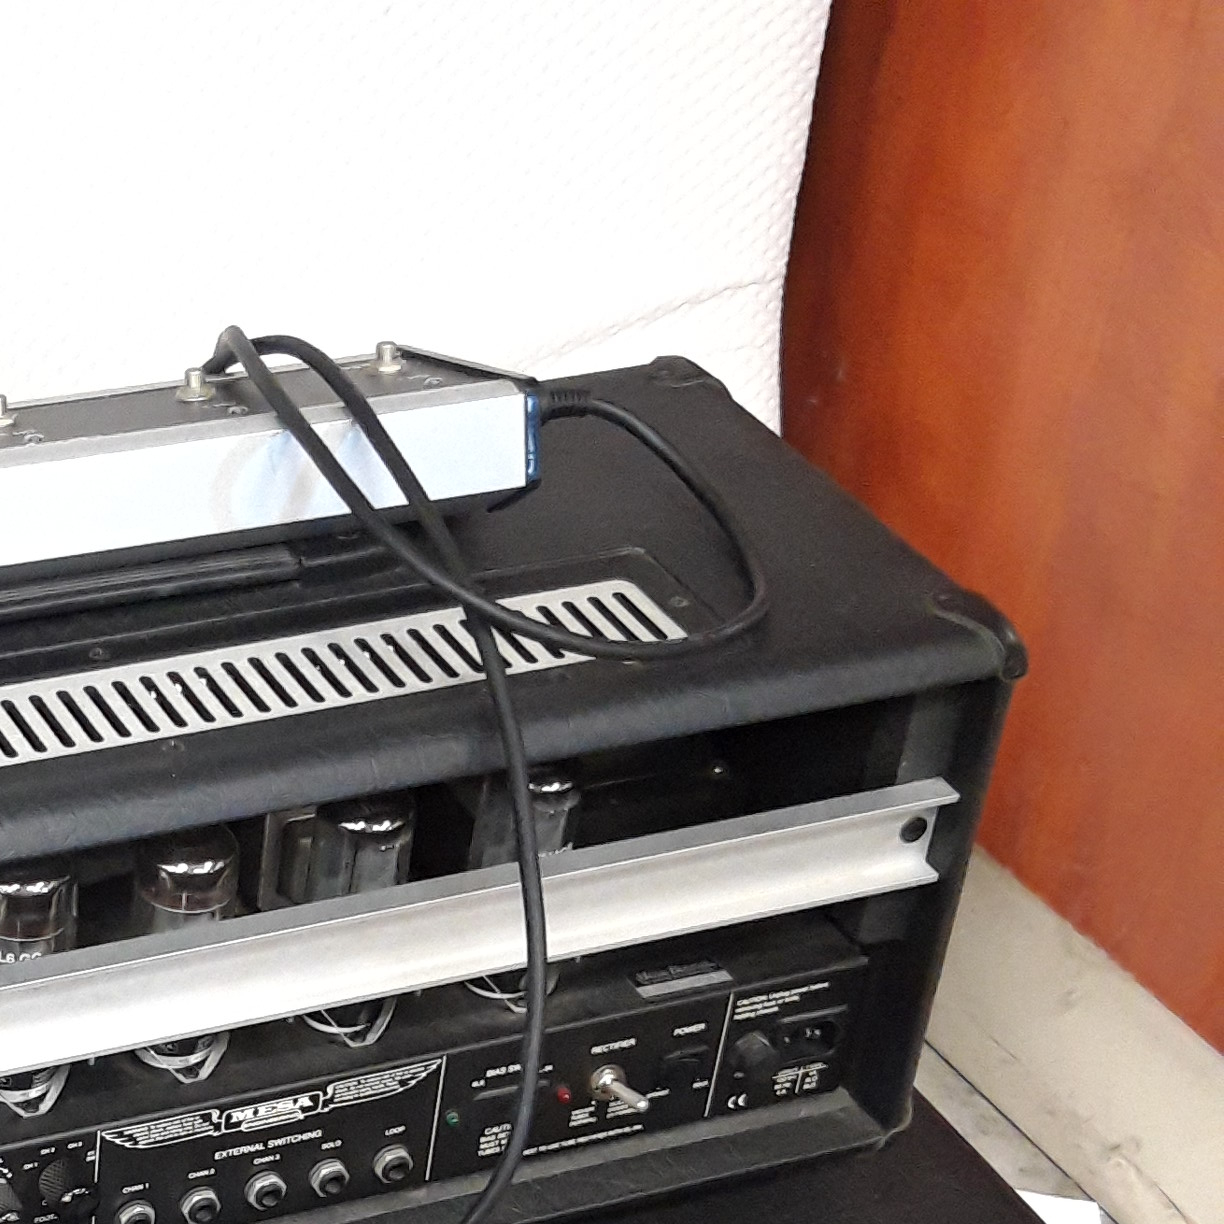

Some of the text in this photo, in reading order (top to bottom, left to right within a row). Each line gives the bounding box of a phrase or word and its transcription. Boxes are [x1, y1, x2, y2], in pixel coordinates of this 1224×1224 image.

[230, 1096, 314, 1123] MESA
[214, 1129, 323, 1160] EXTERNAL SWITCHING
